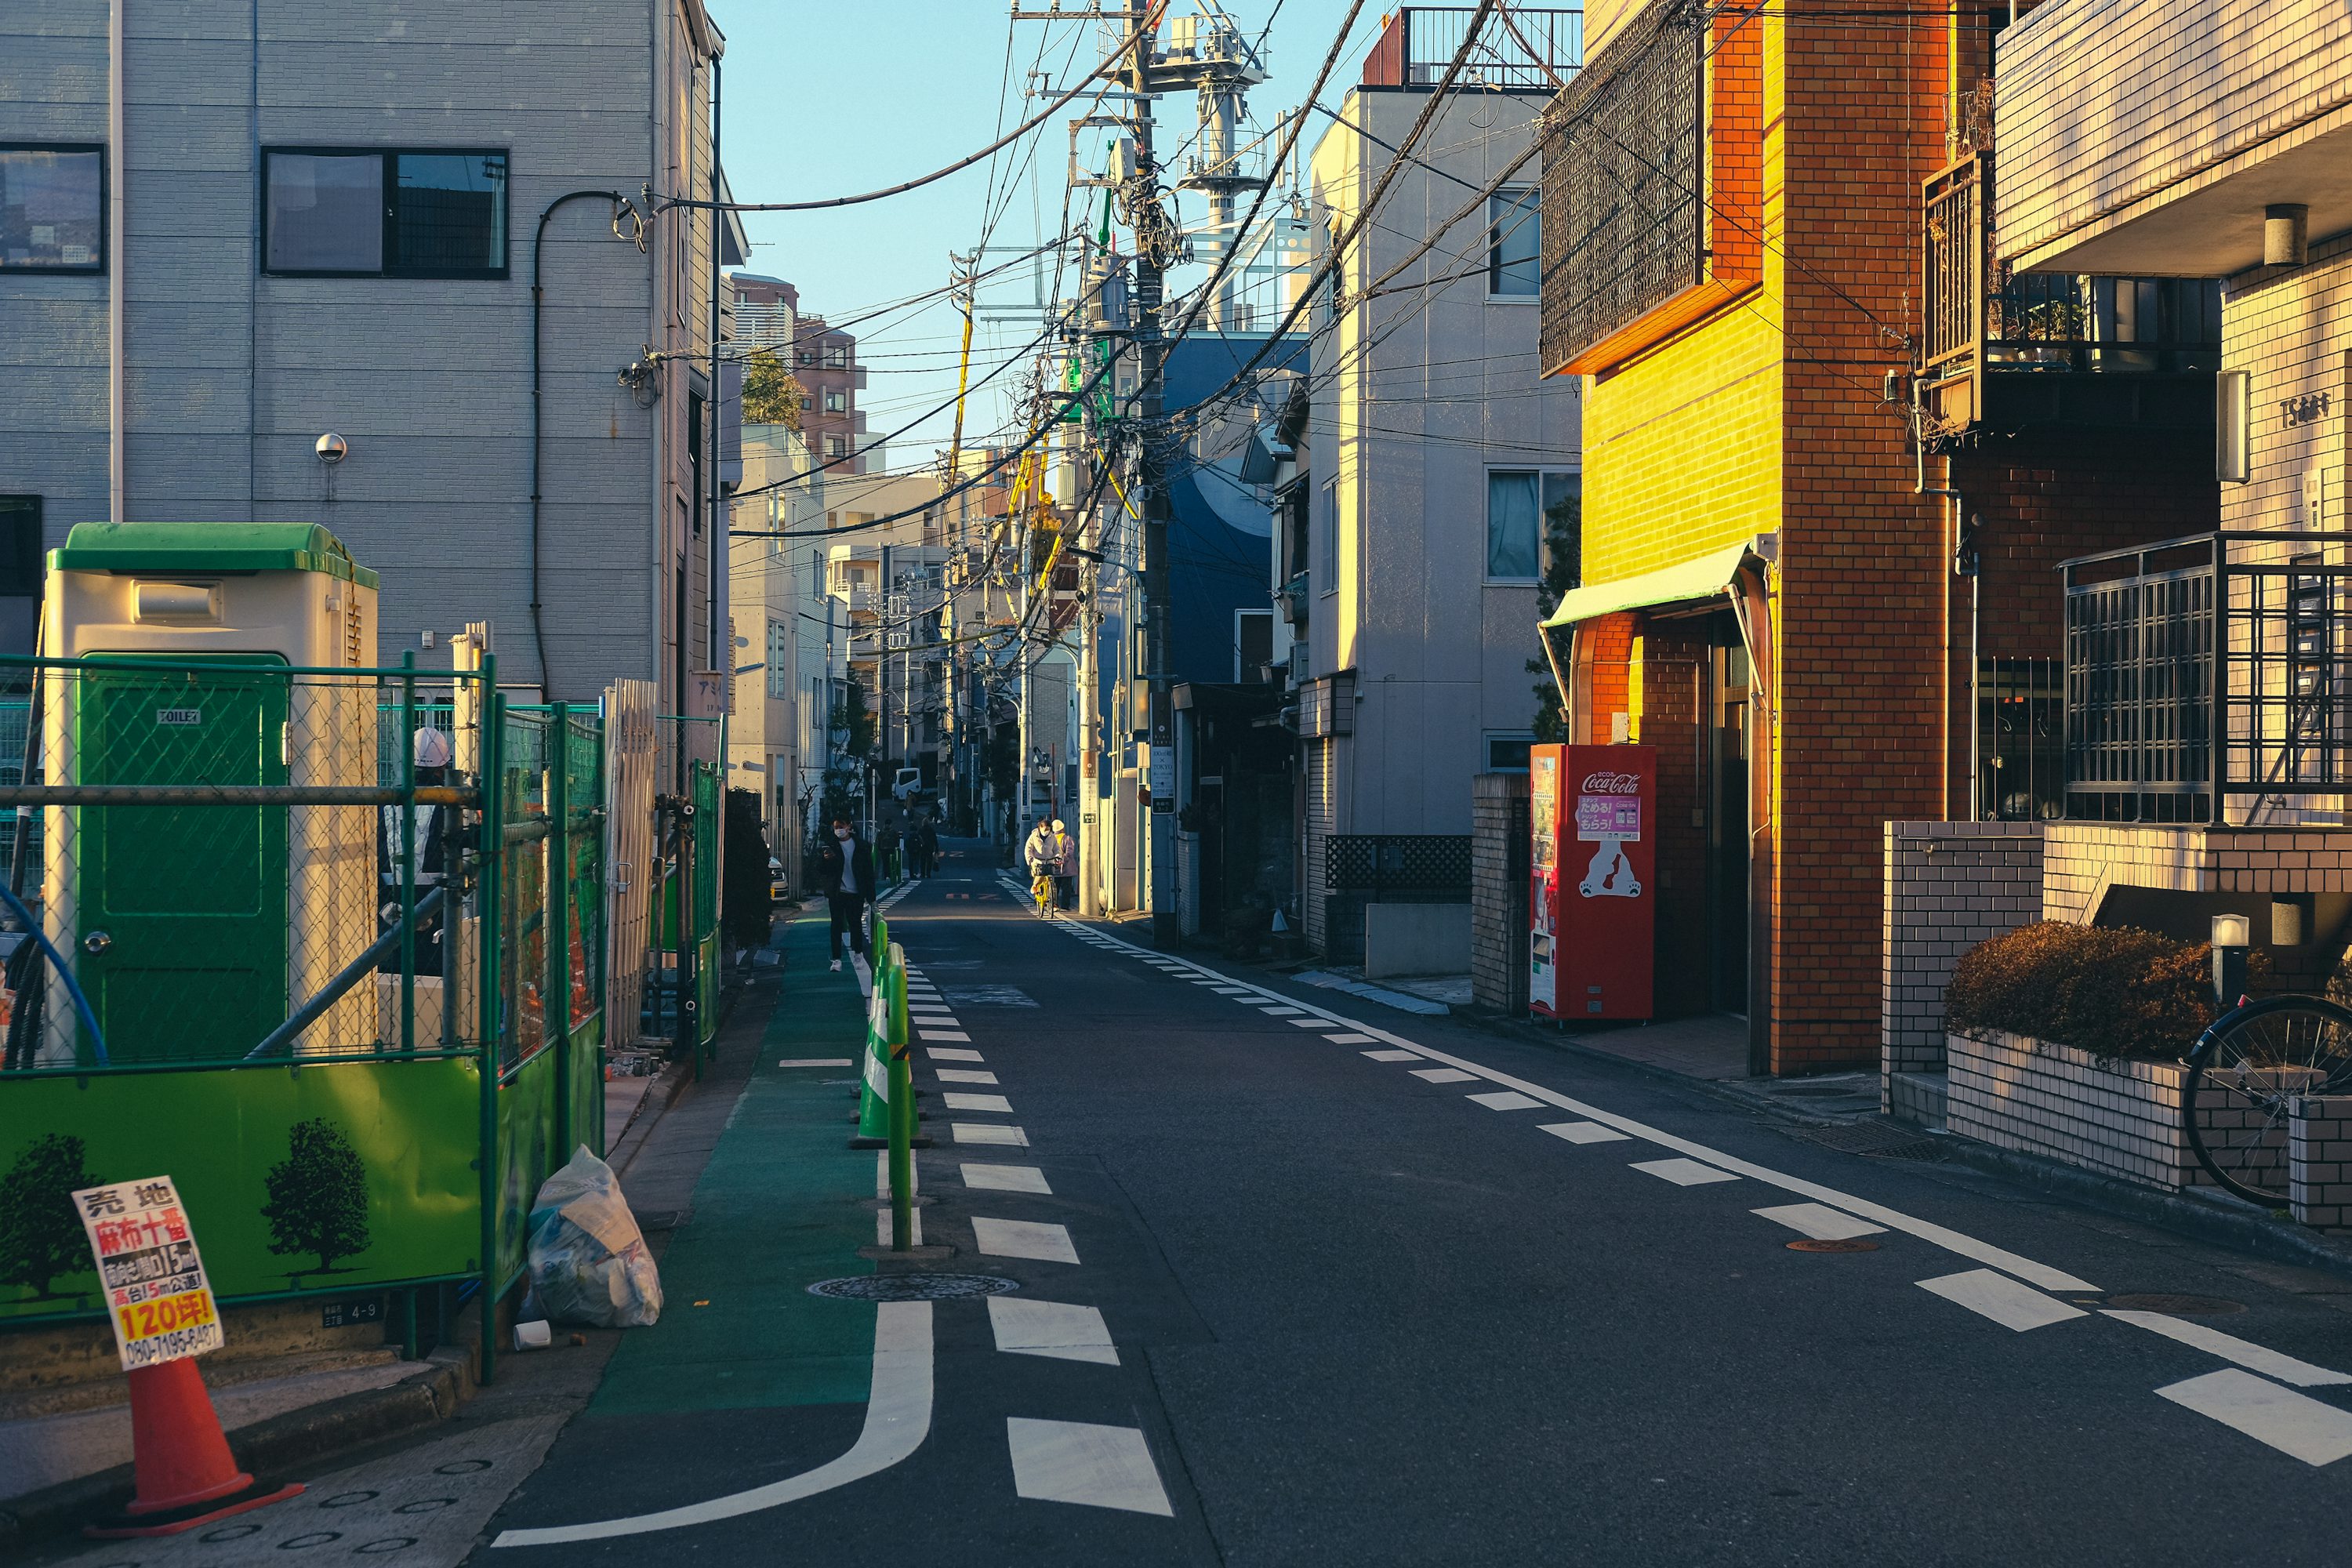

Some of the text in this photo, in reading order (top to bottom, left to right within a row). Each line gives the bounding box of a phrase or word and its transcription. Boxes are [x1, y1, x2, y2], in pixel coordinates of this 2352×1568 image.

[158, 711, 198, 722] TOILET
[1581, 773, 1642, 794] Coca-Cola
[83, 1182, 173, 1218] 売地
[94, 1207, 187, 1256] 麻布十番
[121, 1291, 209, 1340] 120坪!
[325, 1315, 343, 1326] 三丁目
[351, 1303, 376, 1319] 4-9
[125, 1323, 216, 1365] 080-7195-6487
